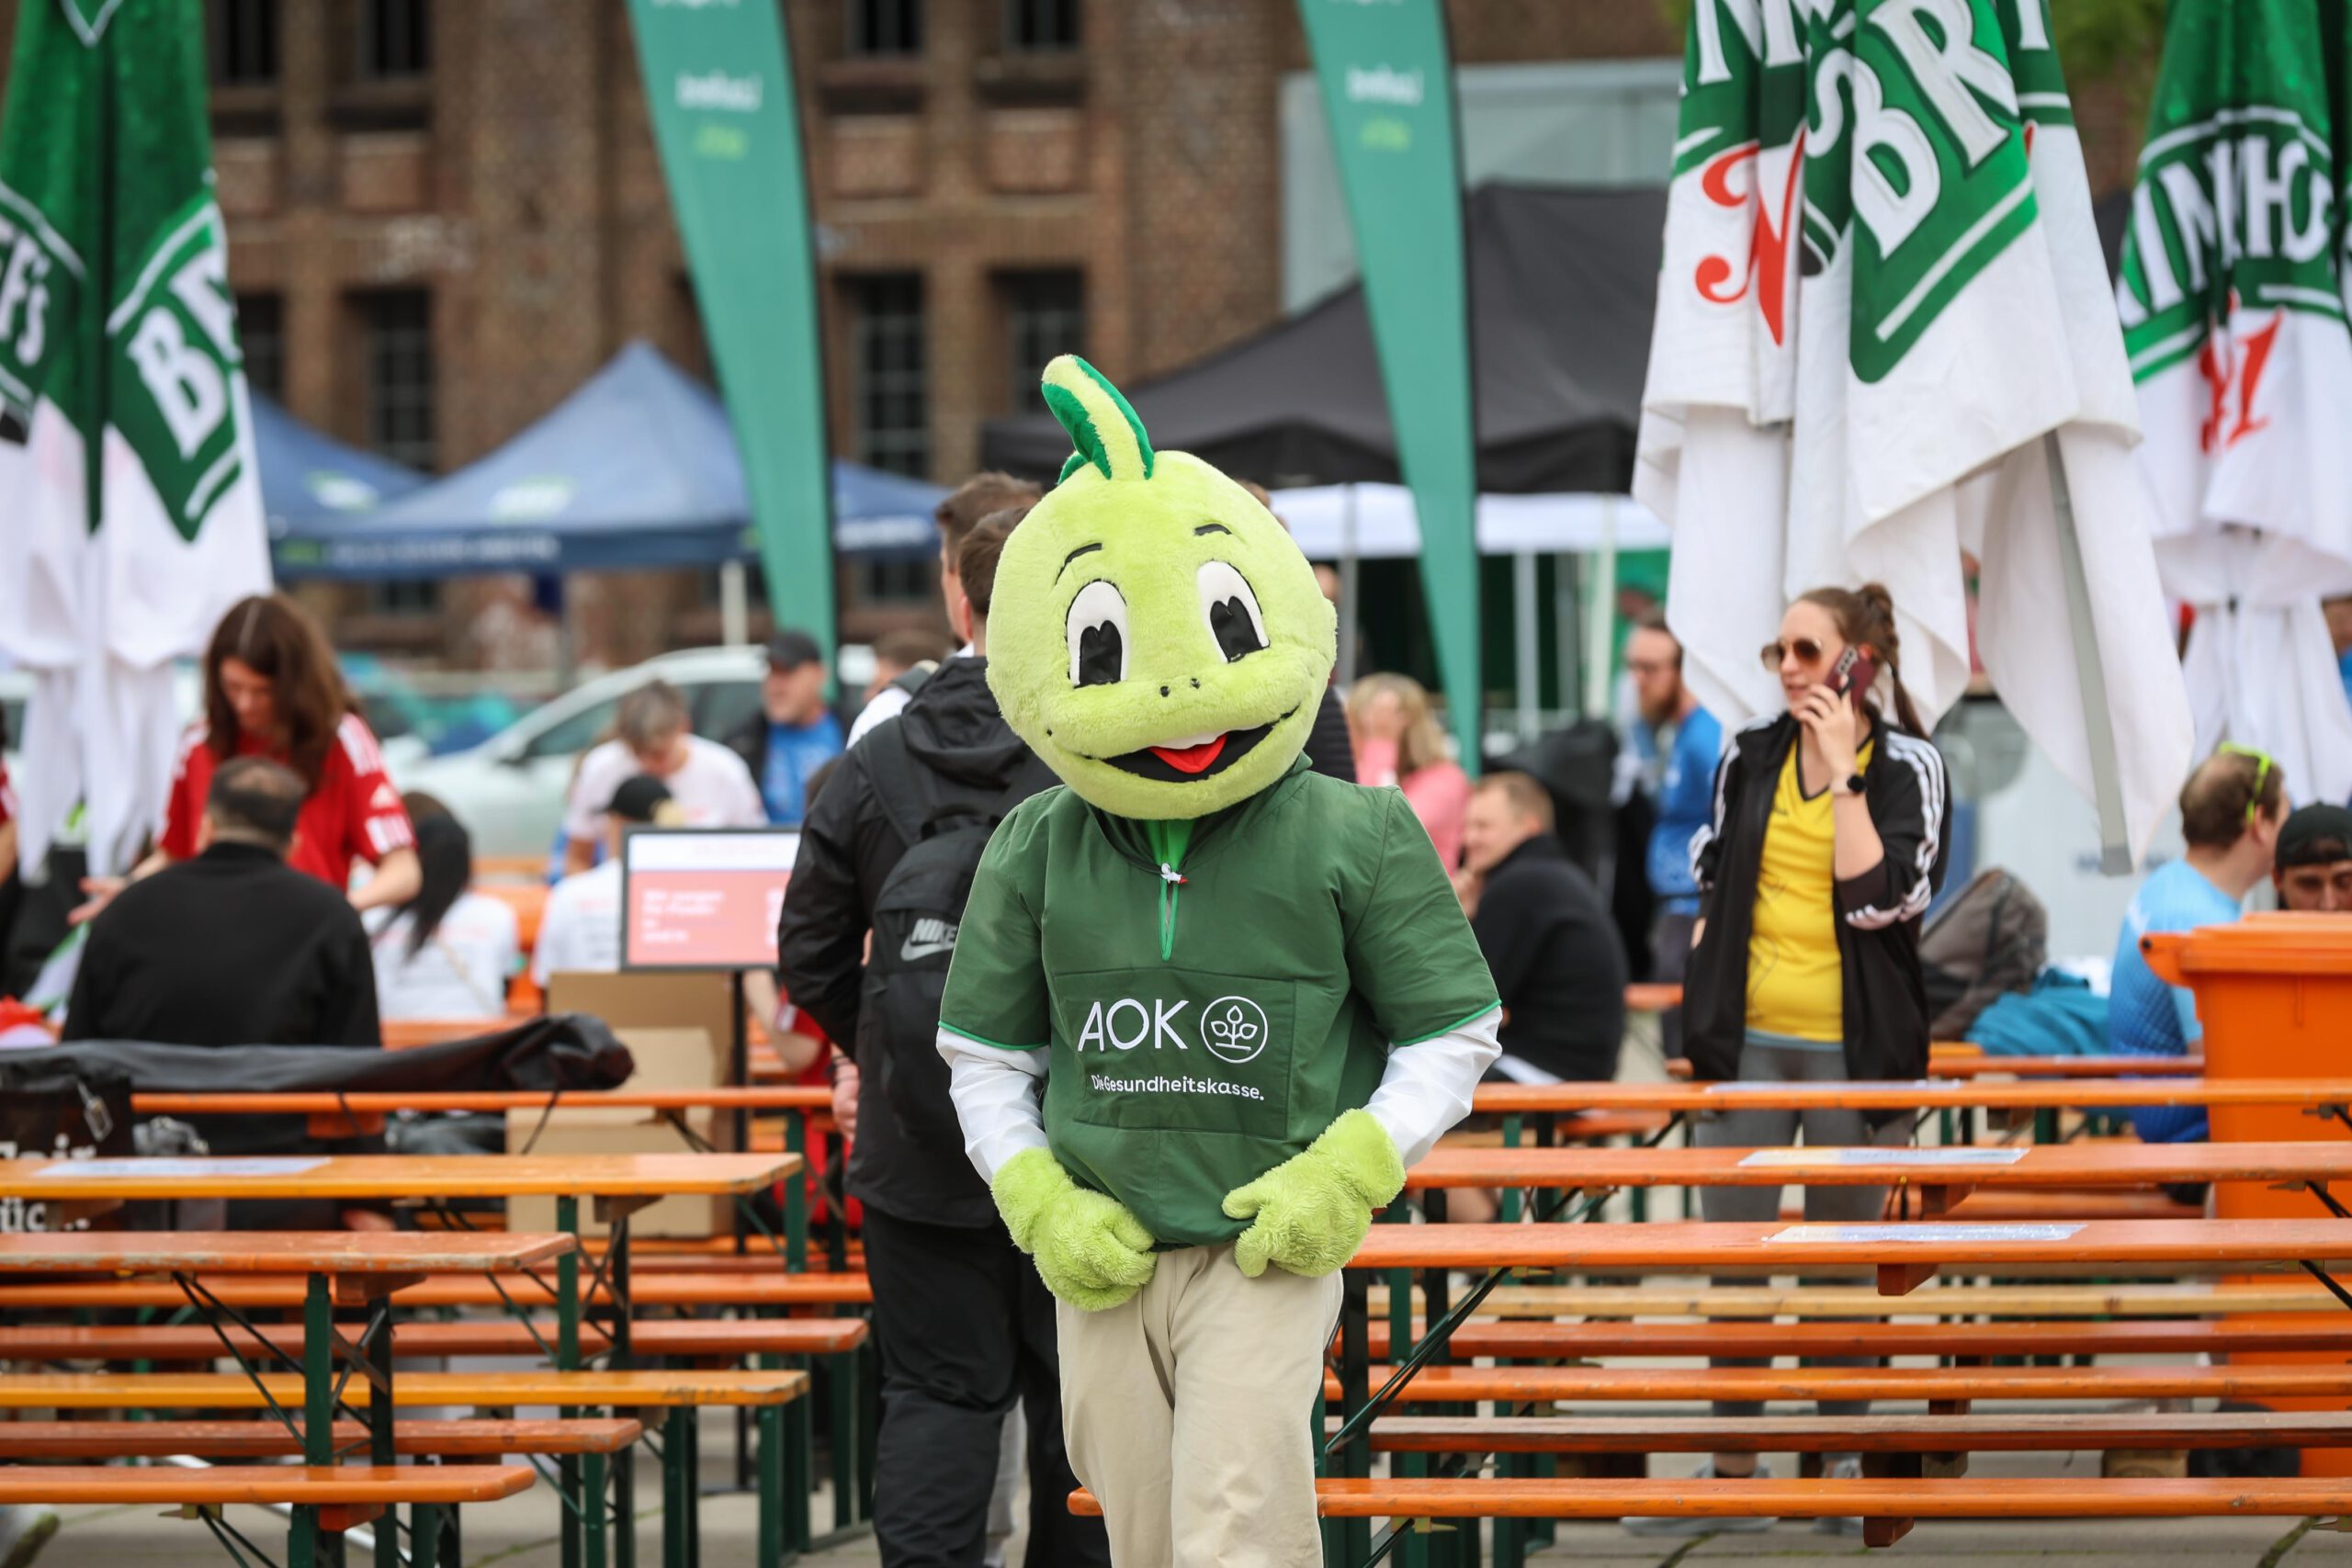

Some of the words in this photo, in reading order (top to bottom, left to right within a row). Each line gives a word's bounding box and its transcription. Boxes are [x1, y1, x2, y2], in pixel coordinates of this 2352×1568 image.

[911, 918, 957, 944] NIKE
[1077, 998, 1189, 1052] AOK
[1103, 1075, 1265, 1100] Gesundheitskasse.
